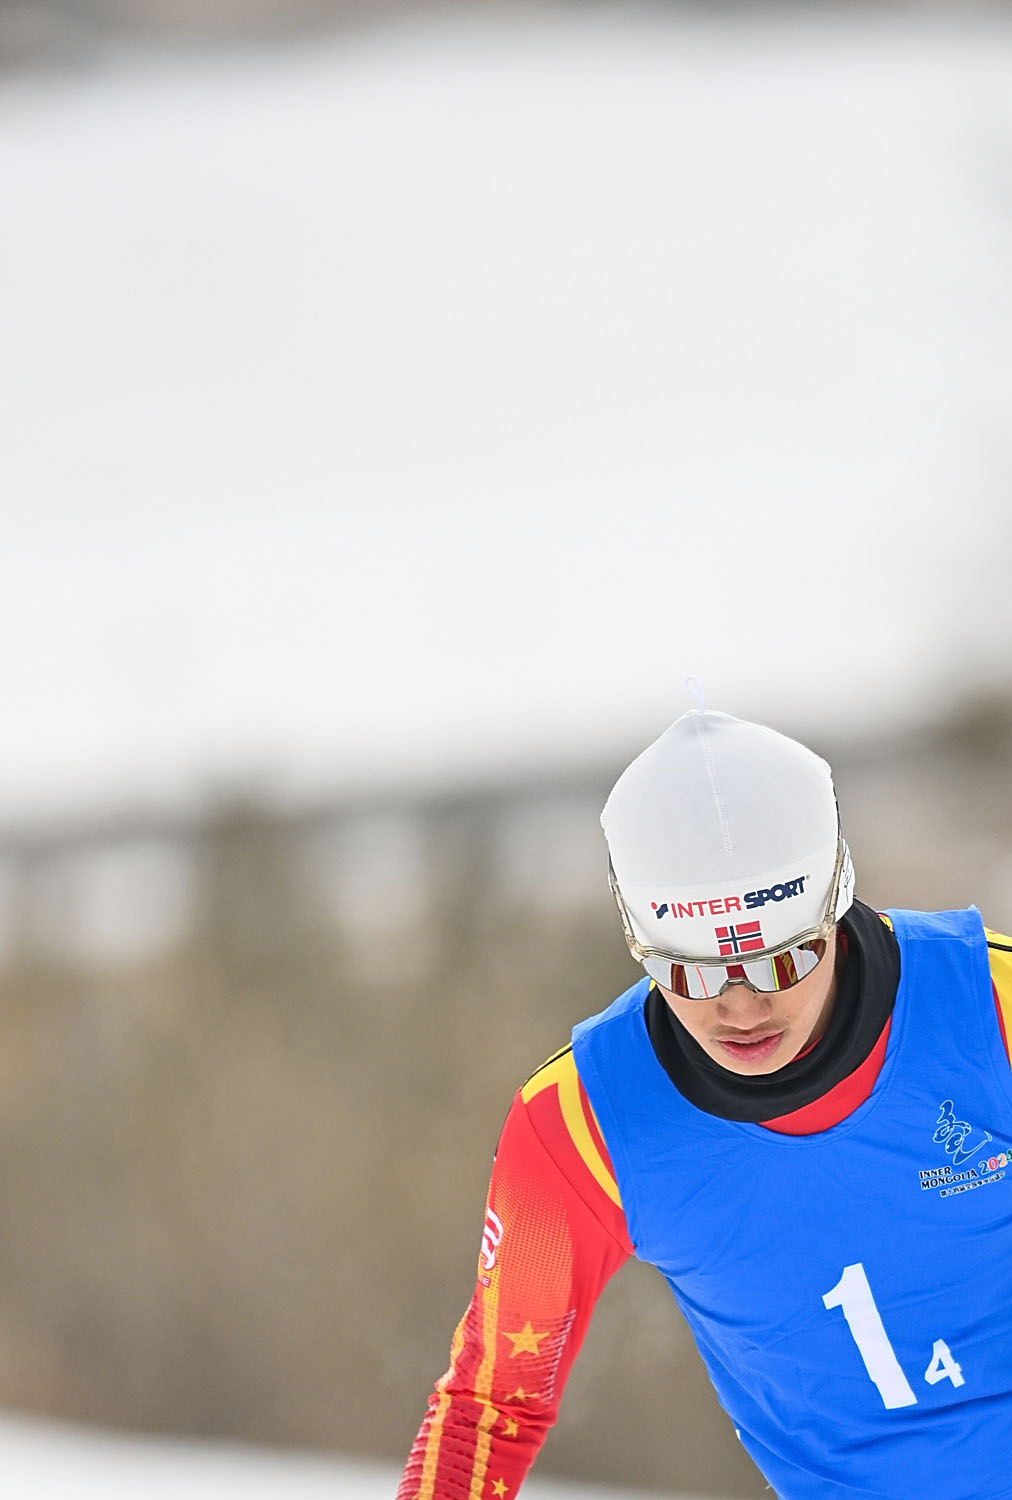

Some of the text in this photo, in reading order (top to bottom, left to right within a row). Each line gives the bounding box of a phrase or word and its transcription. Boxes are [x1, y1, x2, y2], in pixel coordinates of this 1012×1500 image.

[919, 1165, 953, 1180] INNER
[920, 1169, 978, 1191] MONGOLIA
[821, 1262, 966, 1410] 1 4
